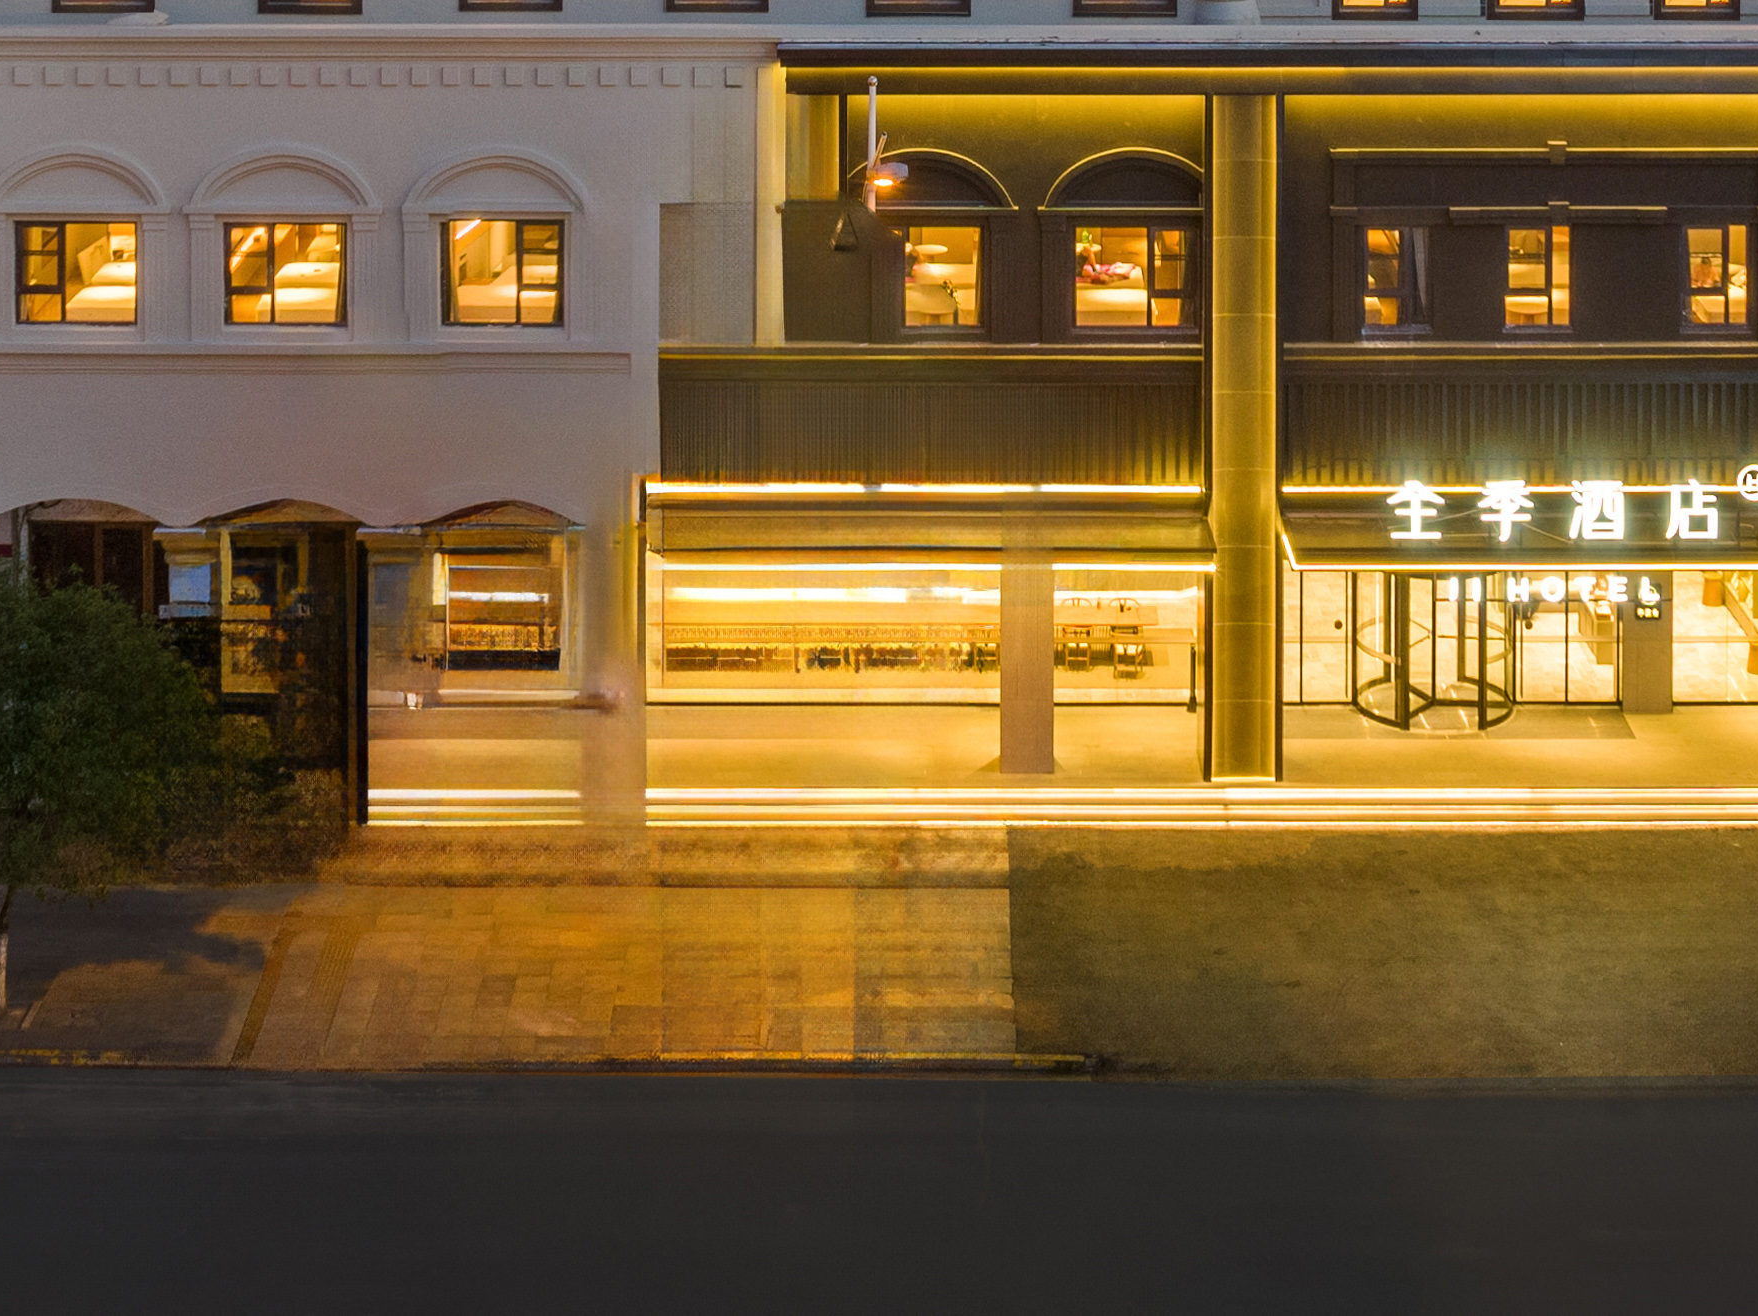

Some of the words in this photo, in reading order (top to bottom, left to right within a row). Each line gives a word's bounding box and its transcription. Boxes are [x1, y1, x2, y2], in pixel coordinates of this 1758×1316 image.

[1385, 479, 1720, 542] 全季酒店
[1506, 575, 1661, 604] HOTEL
